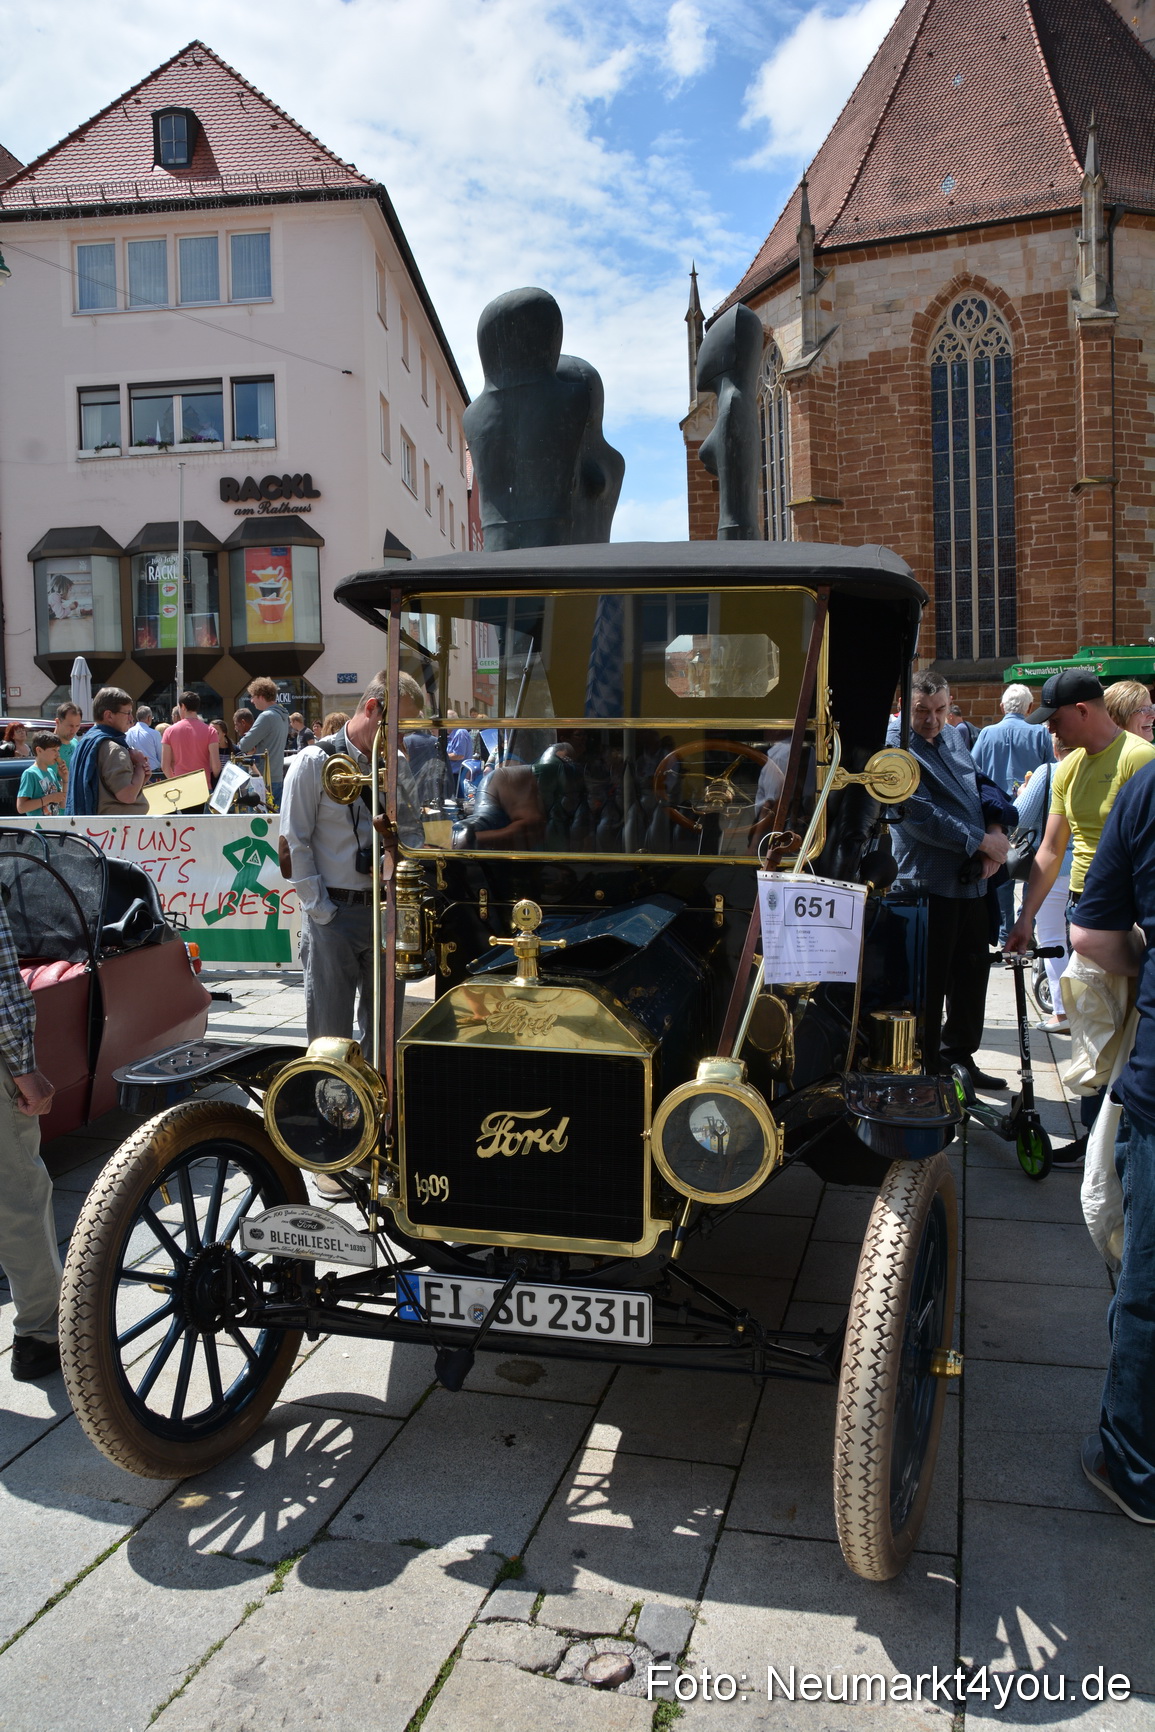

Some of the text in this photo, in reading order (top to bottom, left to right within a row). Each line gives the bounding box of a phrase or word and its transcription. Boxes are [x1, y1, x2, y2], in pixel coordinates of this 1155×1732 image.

[219, 473, 321, 502] RACKL
[257, 501, 312, 514] Rathaus
[148, 565, 180, 581] RACKL
[1024, 666, 1059, 676] Neumarkter
[275, 692, 292, 703] ACKL
[137, 826, 196, 852] UNS
[794, 896, 836, 918] 651
[485, 999, 558, 1036] Ford
[475, 1107, 570, 1159] Ford
[414, 1172, 450, 1205] 1909
[296, 1219, 318, 1230] Ford
[270, 1230, 344, 1252] BLECHLIESEL
[424, 1281, 466, 1320] EI
[548, 1294, 645, 1338] 233H
